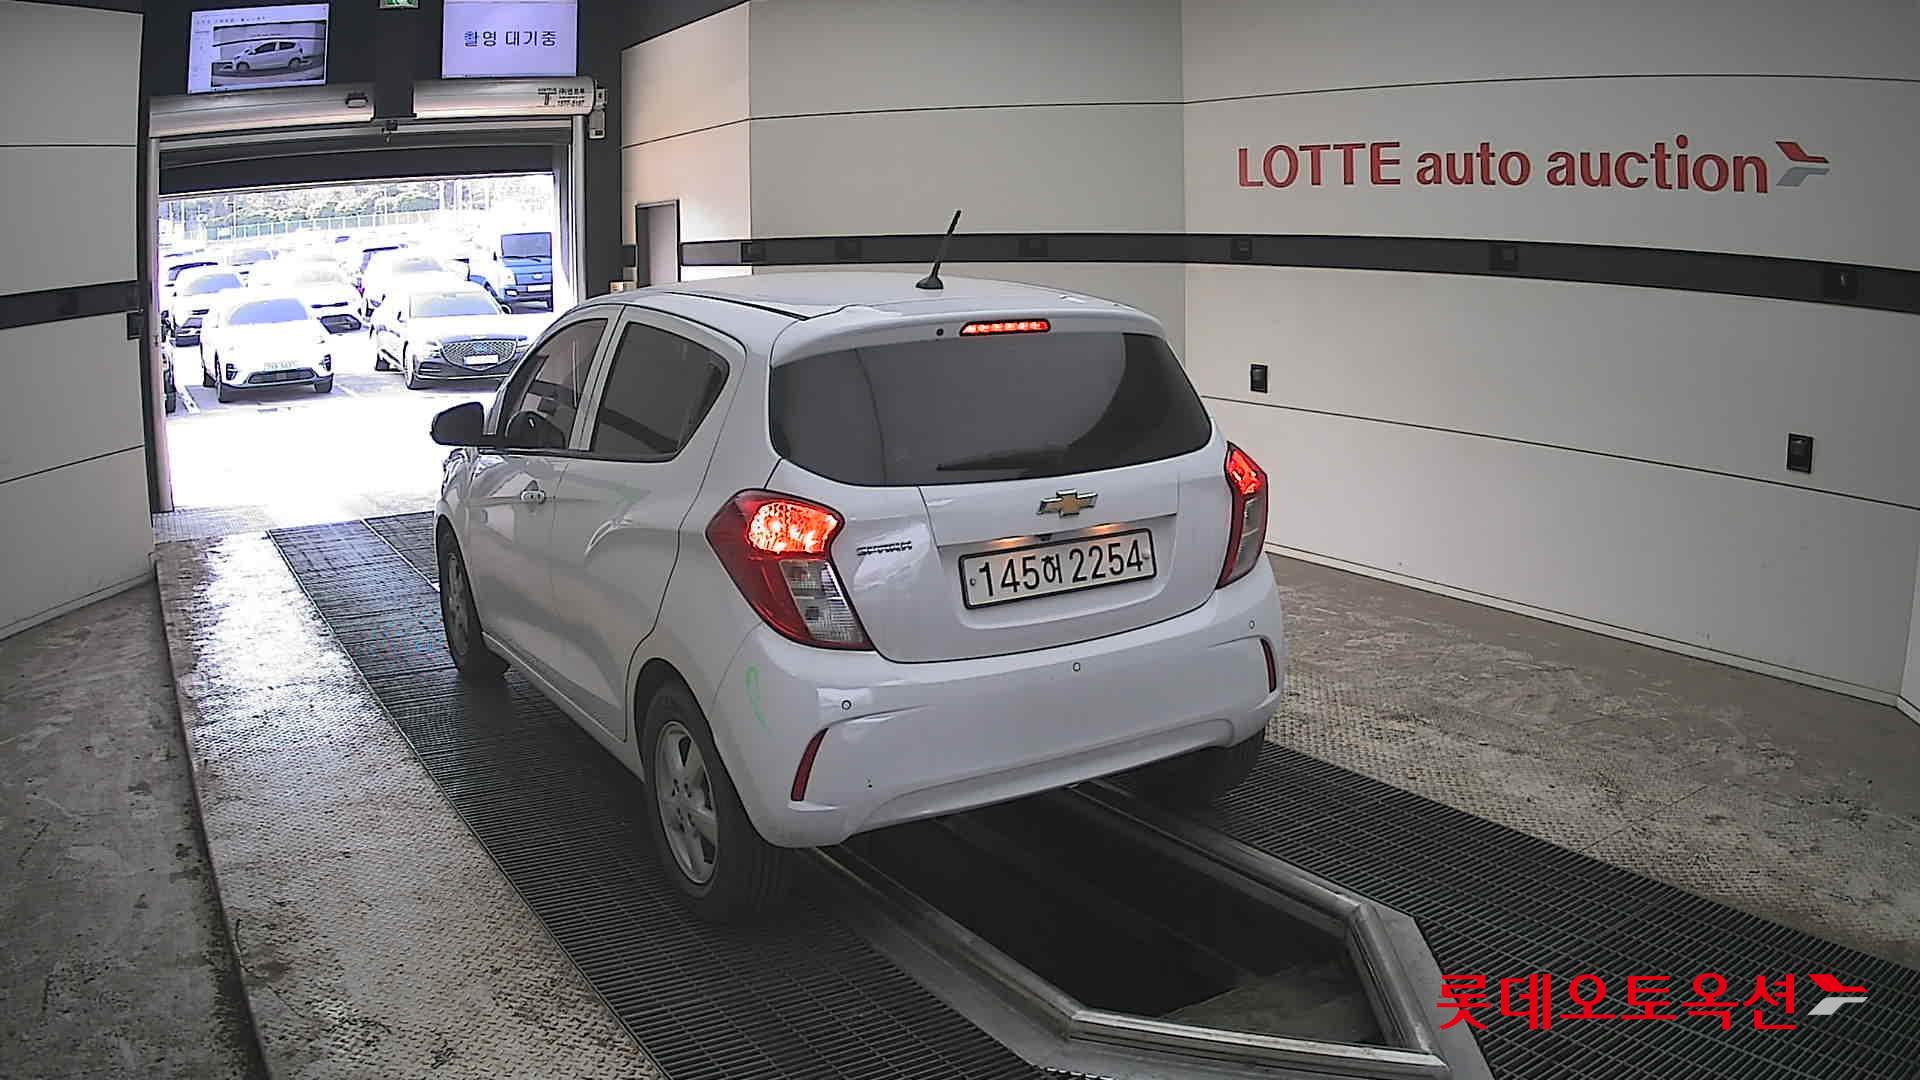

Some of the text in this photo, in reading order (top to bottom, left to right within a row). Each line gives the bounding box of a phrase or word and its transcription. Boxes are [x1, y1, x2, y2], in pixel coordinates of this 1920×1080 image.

[505, 30, 557, 47] 대기중
[1238, 134, 1769, 194] LOTTE auto auction
[979, 539, 1144, 597] 145허 2254
